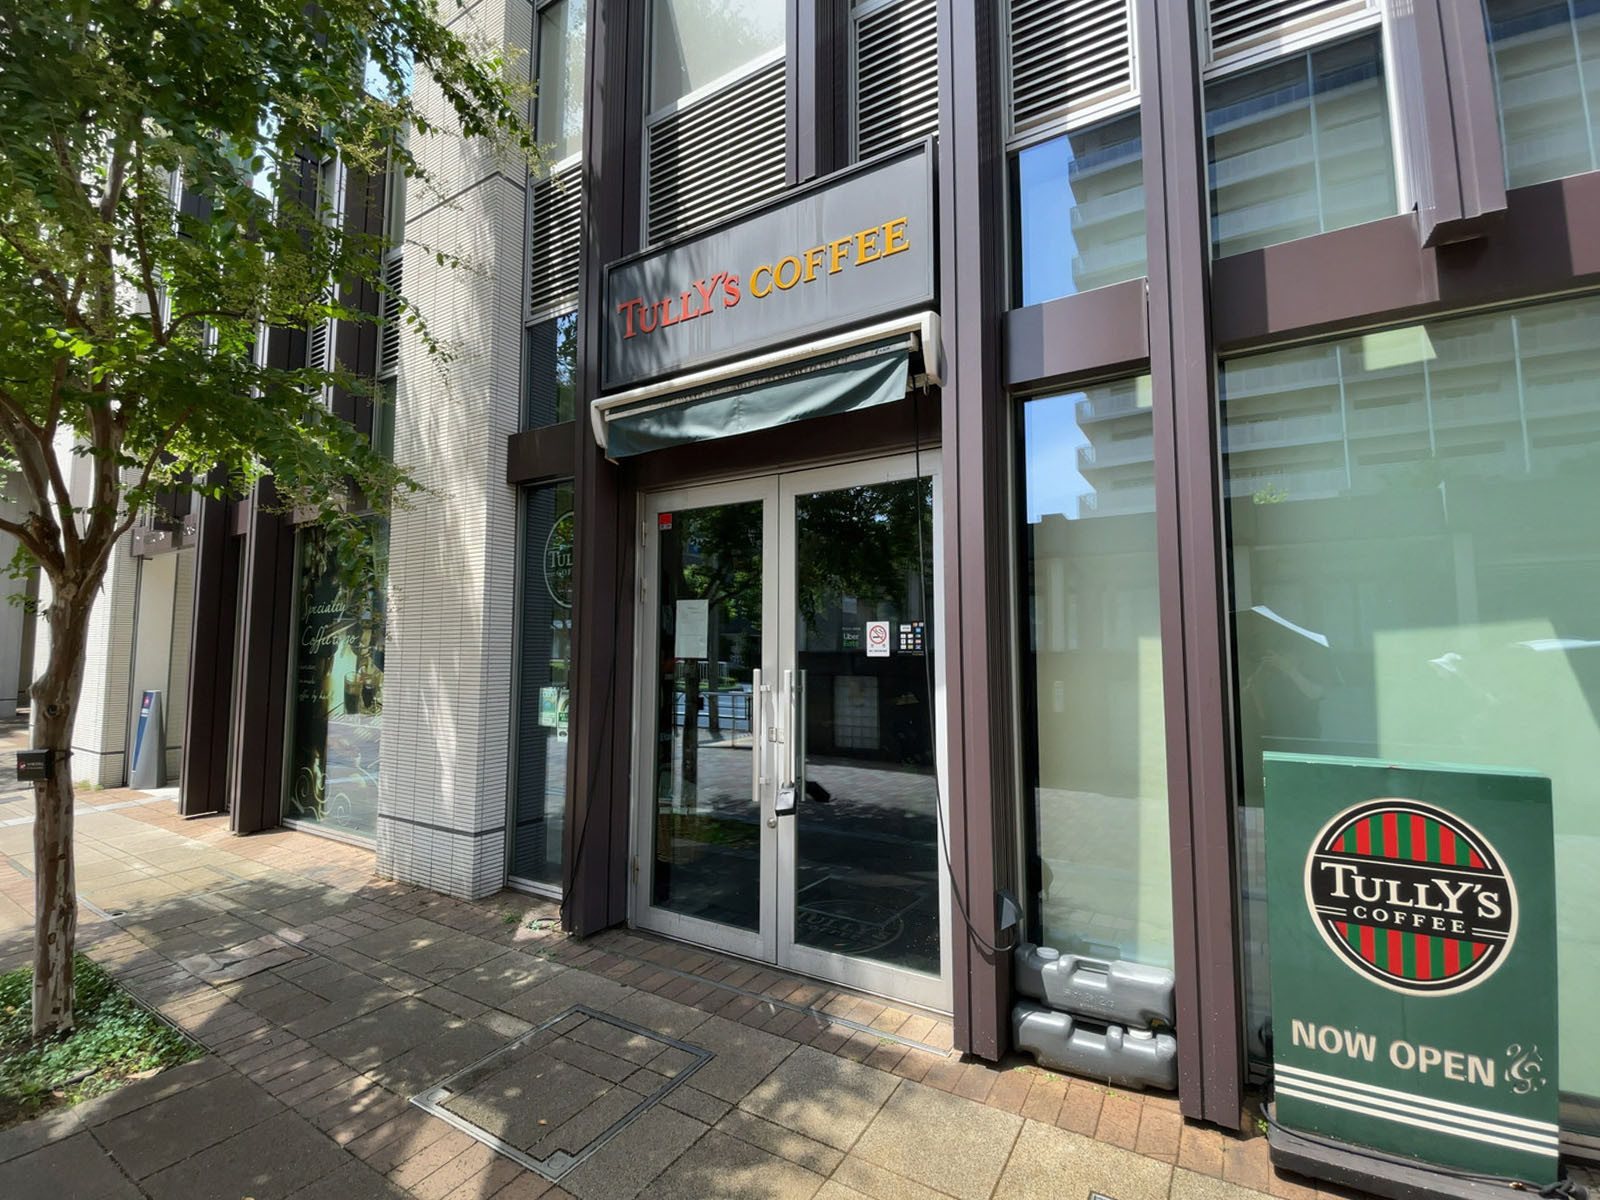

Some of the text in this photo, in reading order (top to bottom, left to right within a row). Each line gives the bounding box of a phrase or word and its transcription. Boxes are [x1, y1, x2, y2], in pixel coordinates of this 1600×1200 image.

[749, 216, 910, 298] COFFEE
[1352, 904, 1466, 936] COFFEE
[1291, 1018, 1496, 1088] NOW OPEN
